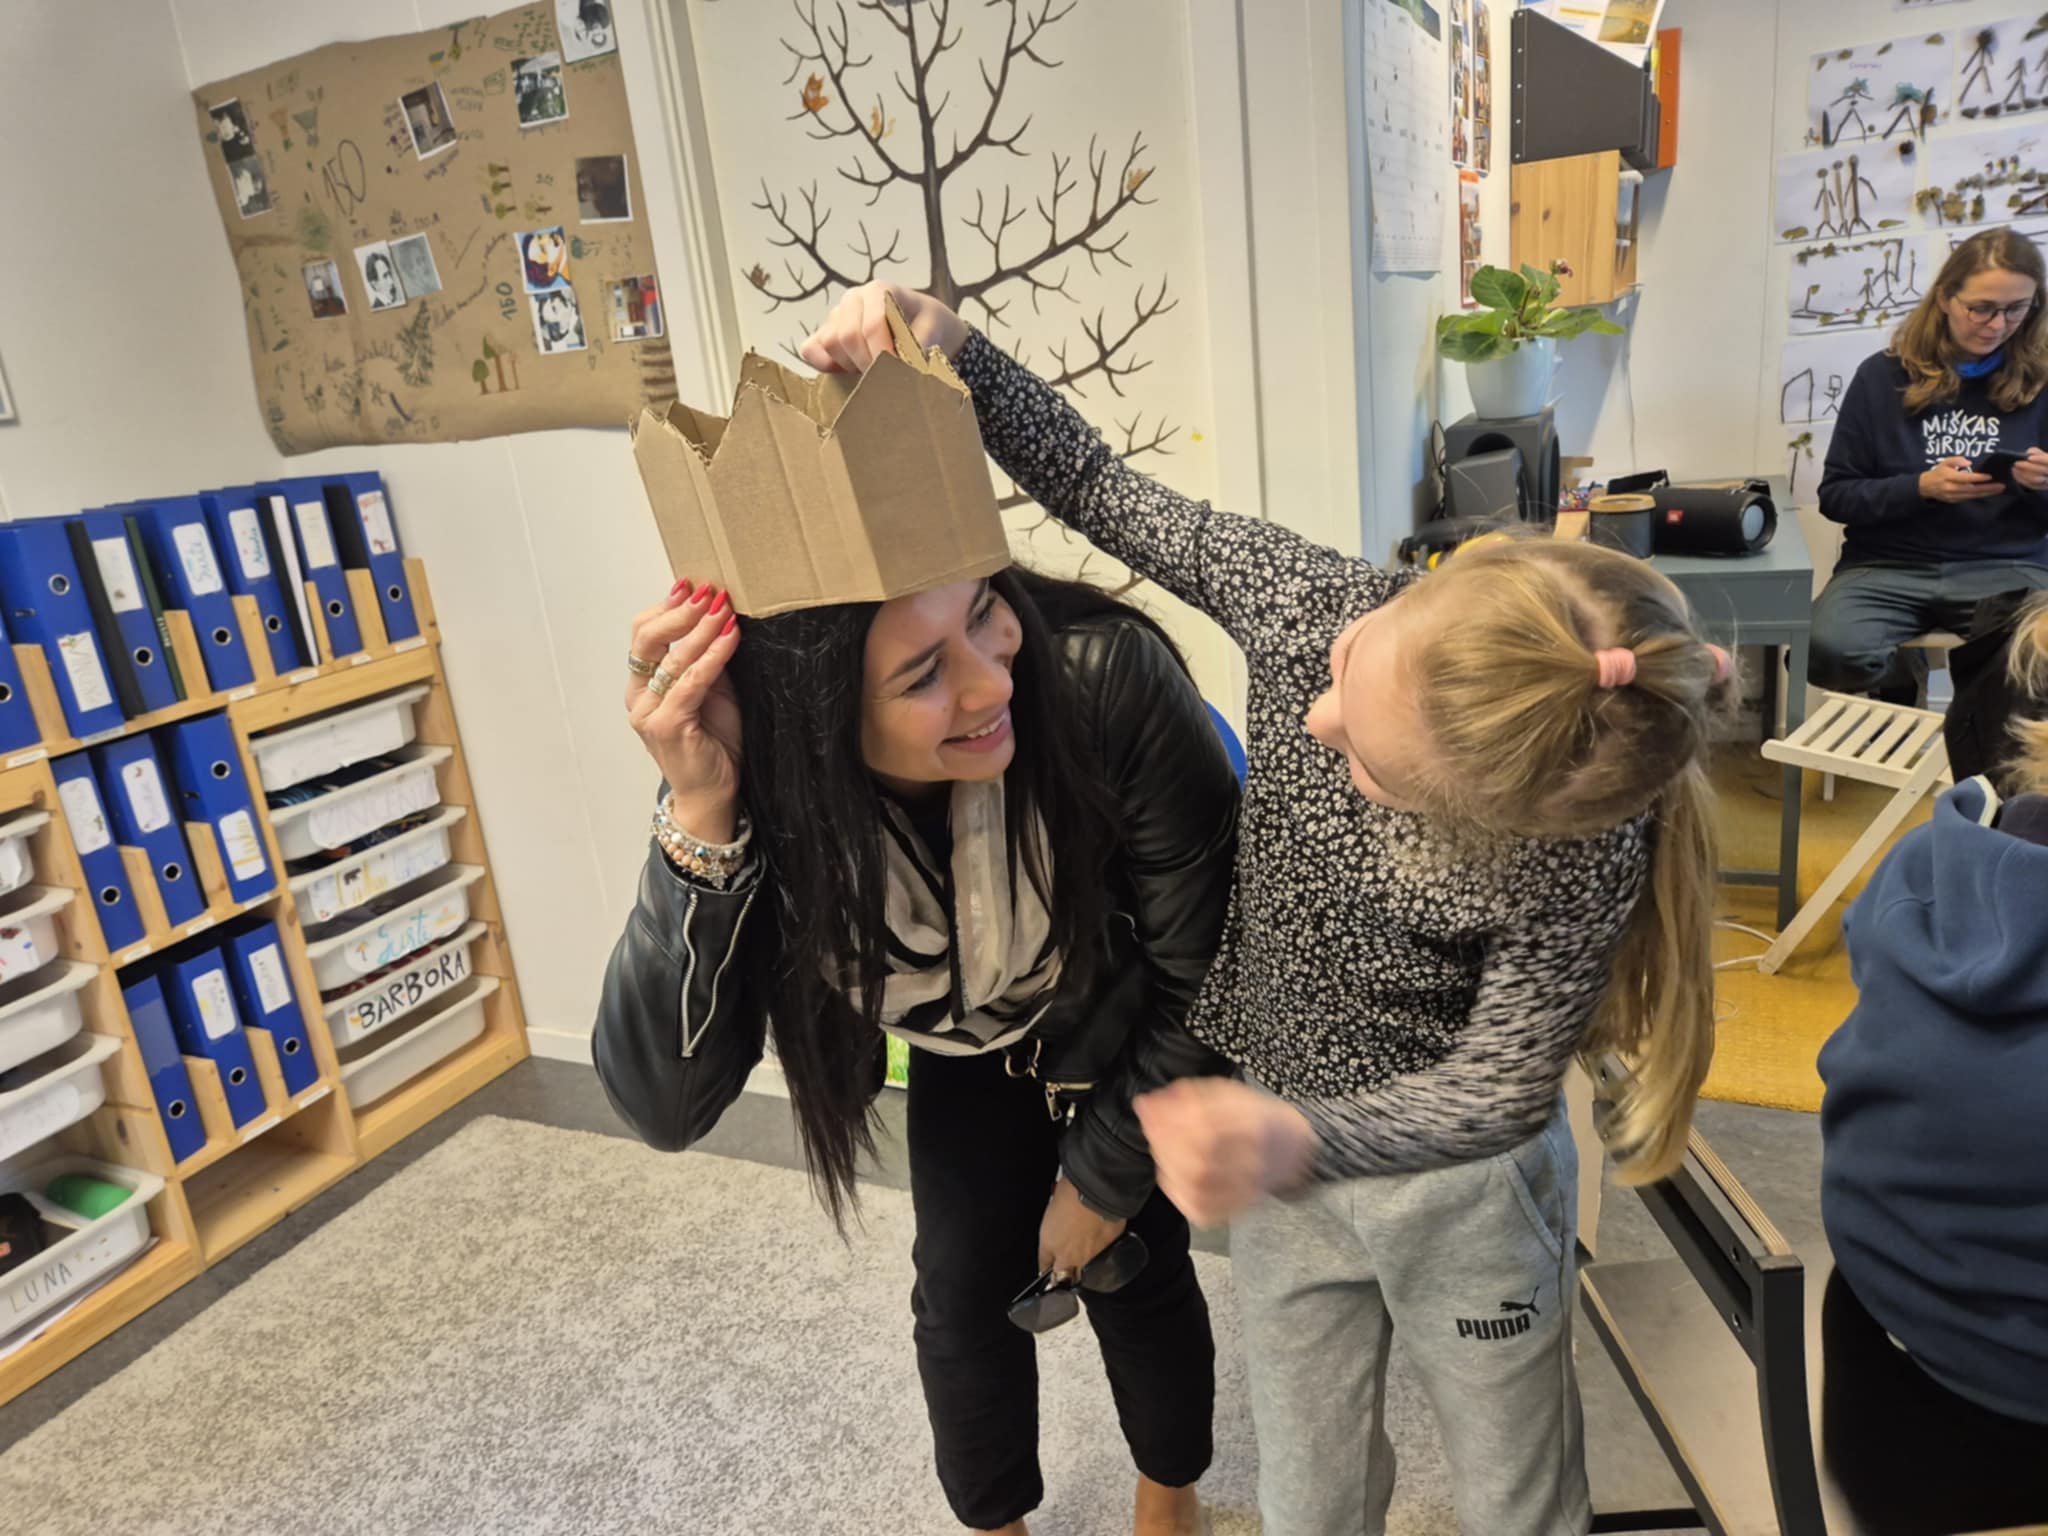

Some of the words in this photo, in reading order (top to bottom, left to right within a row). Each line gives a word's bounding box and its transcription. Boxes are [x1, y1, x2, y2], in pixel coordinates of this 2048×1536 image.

[322, 139, 367, 217] 150
[1925, 433, 2000, 457] ŠIRDYJE
[358, 950, 466, 1029] BARBORA
[9, 1262, 73, 1314] LUNA
[1456, 1312, 1531, 1340] PUMA
